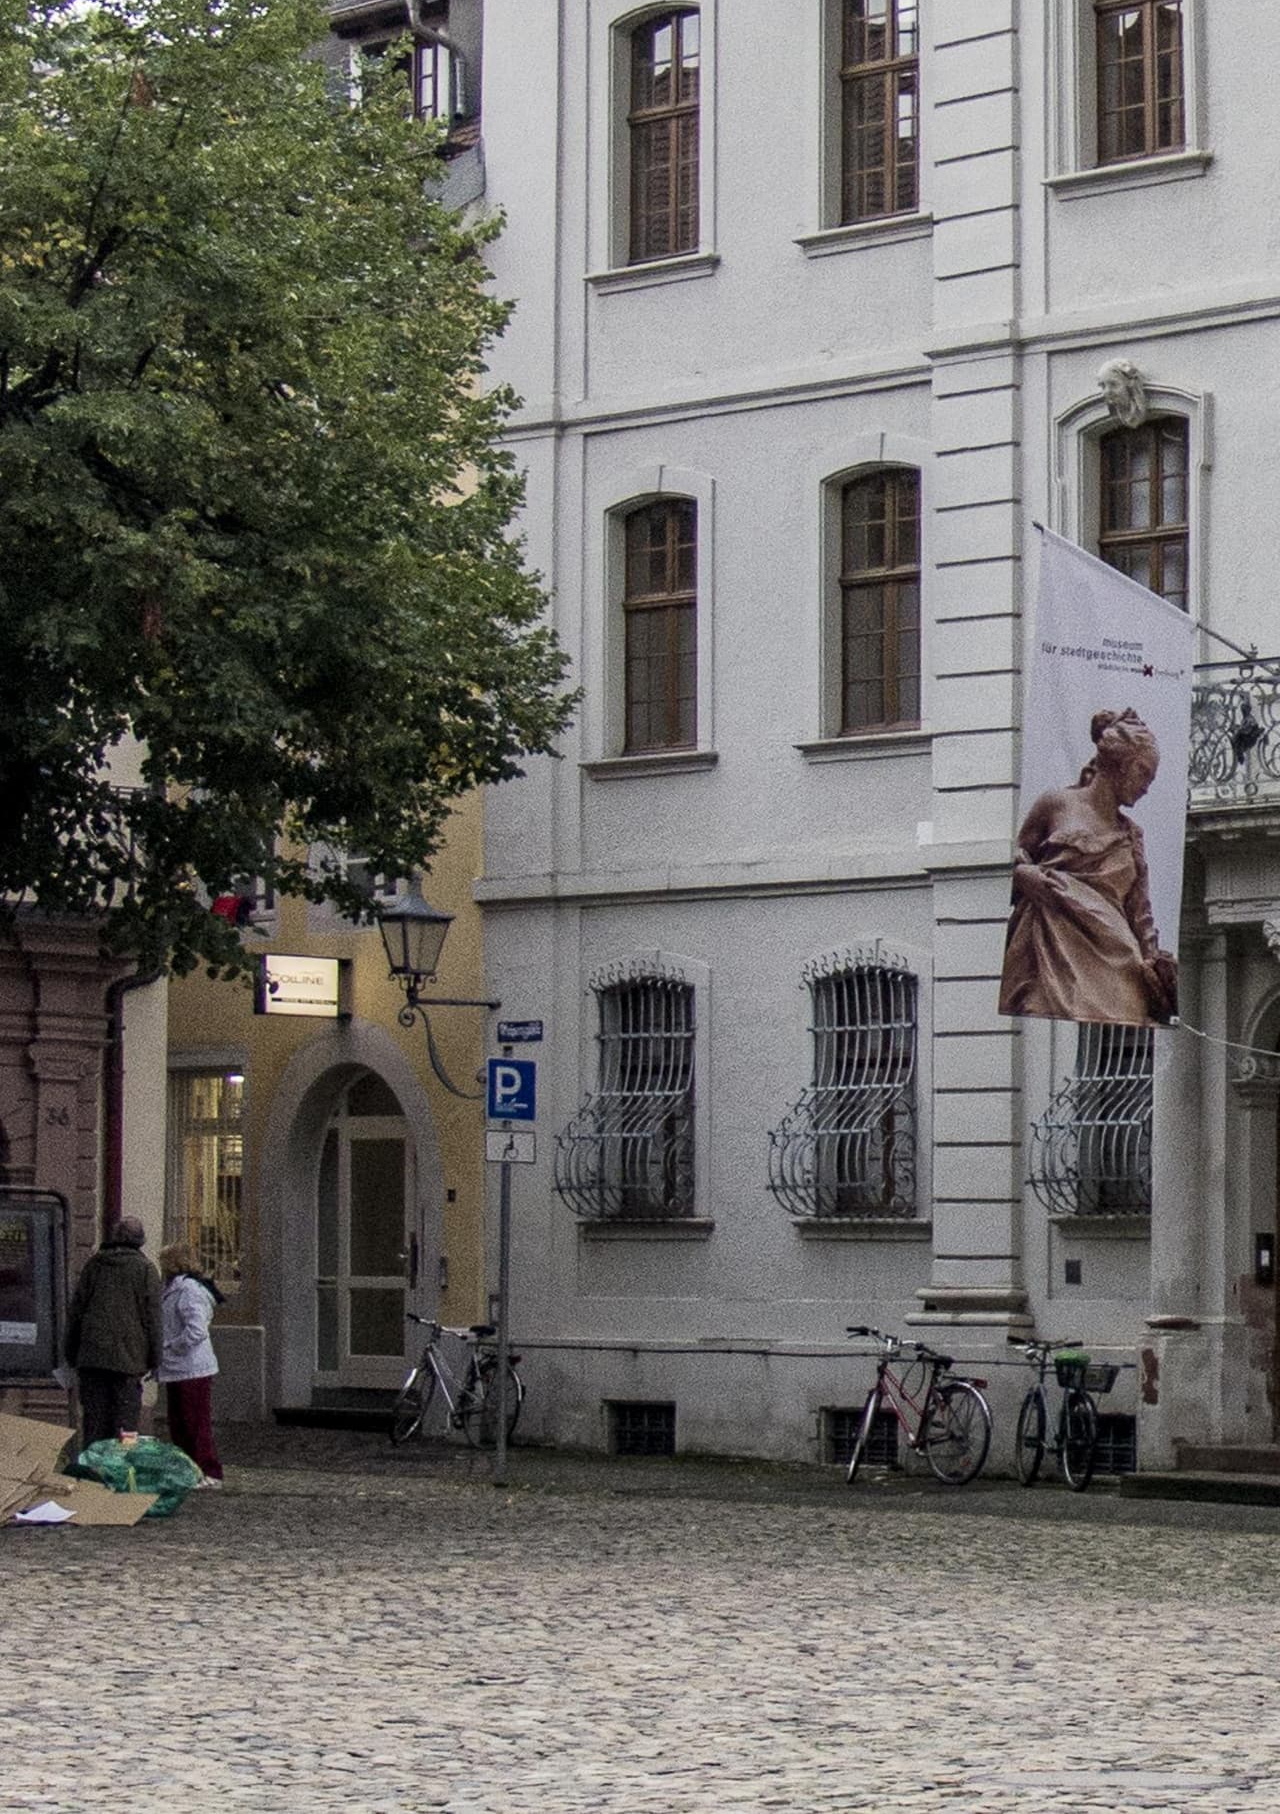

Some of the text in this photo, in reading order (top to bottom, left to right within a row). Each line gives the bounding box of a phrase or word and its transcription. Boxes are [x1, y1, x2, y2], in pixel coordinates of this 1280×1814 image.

[1041, 642, 1144, 664] für stadtgeschichte
[1102, 638, 1144, 651] museum
[495, 1066, 523, 1104] P
